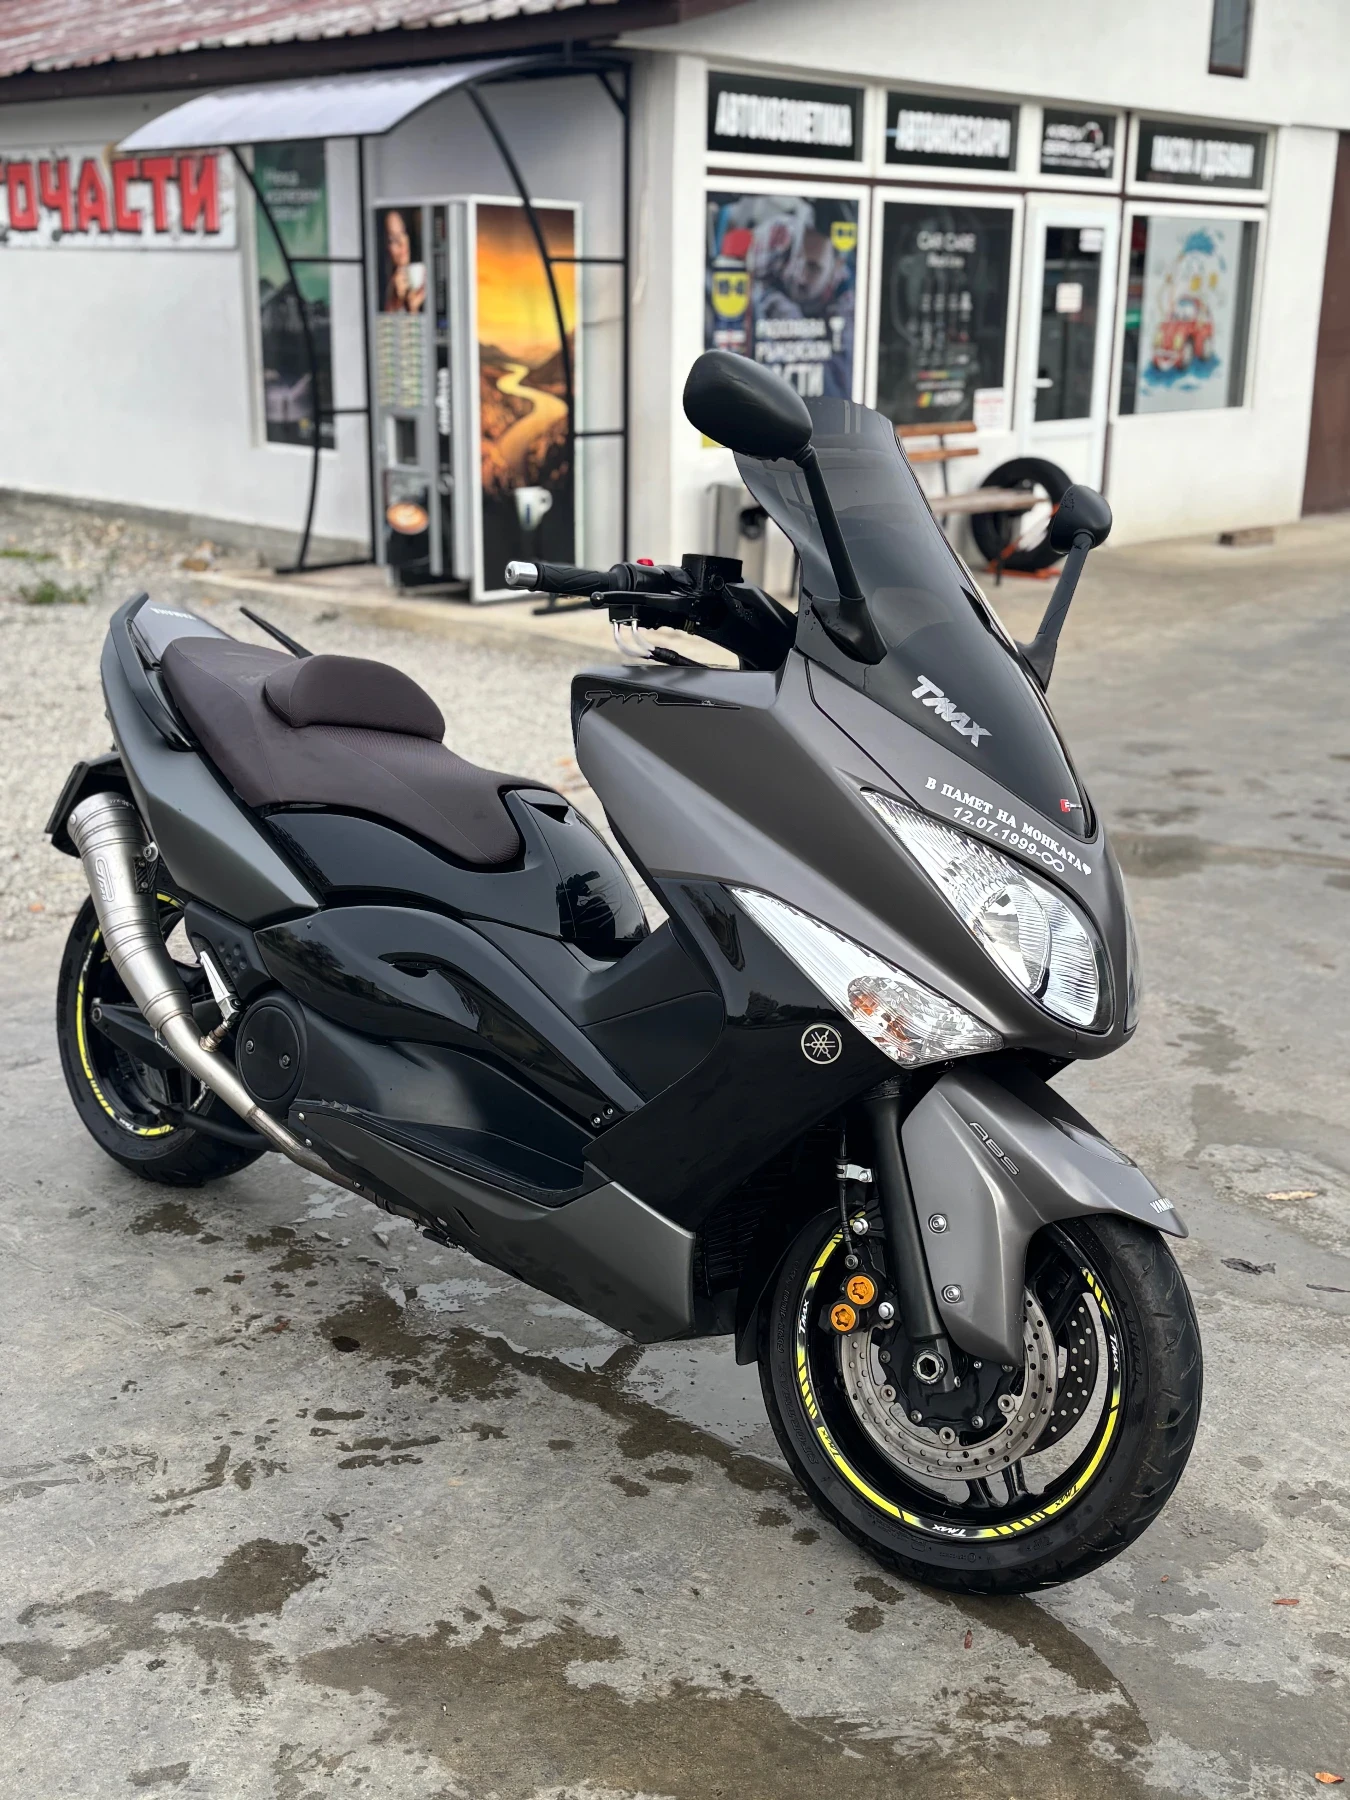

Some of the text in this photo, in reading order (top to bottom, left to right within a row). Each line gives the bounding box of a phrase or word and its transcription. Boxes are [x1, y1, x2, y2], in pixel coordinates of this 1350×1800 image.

[0, 155, 220, 234] ОЧАСТИ
[925, 777, 1083, 871] В ПАМЕТ НА МОНКАТА
[969, 1122, 1020, 1176] ABS
